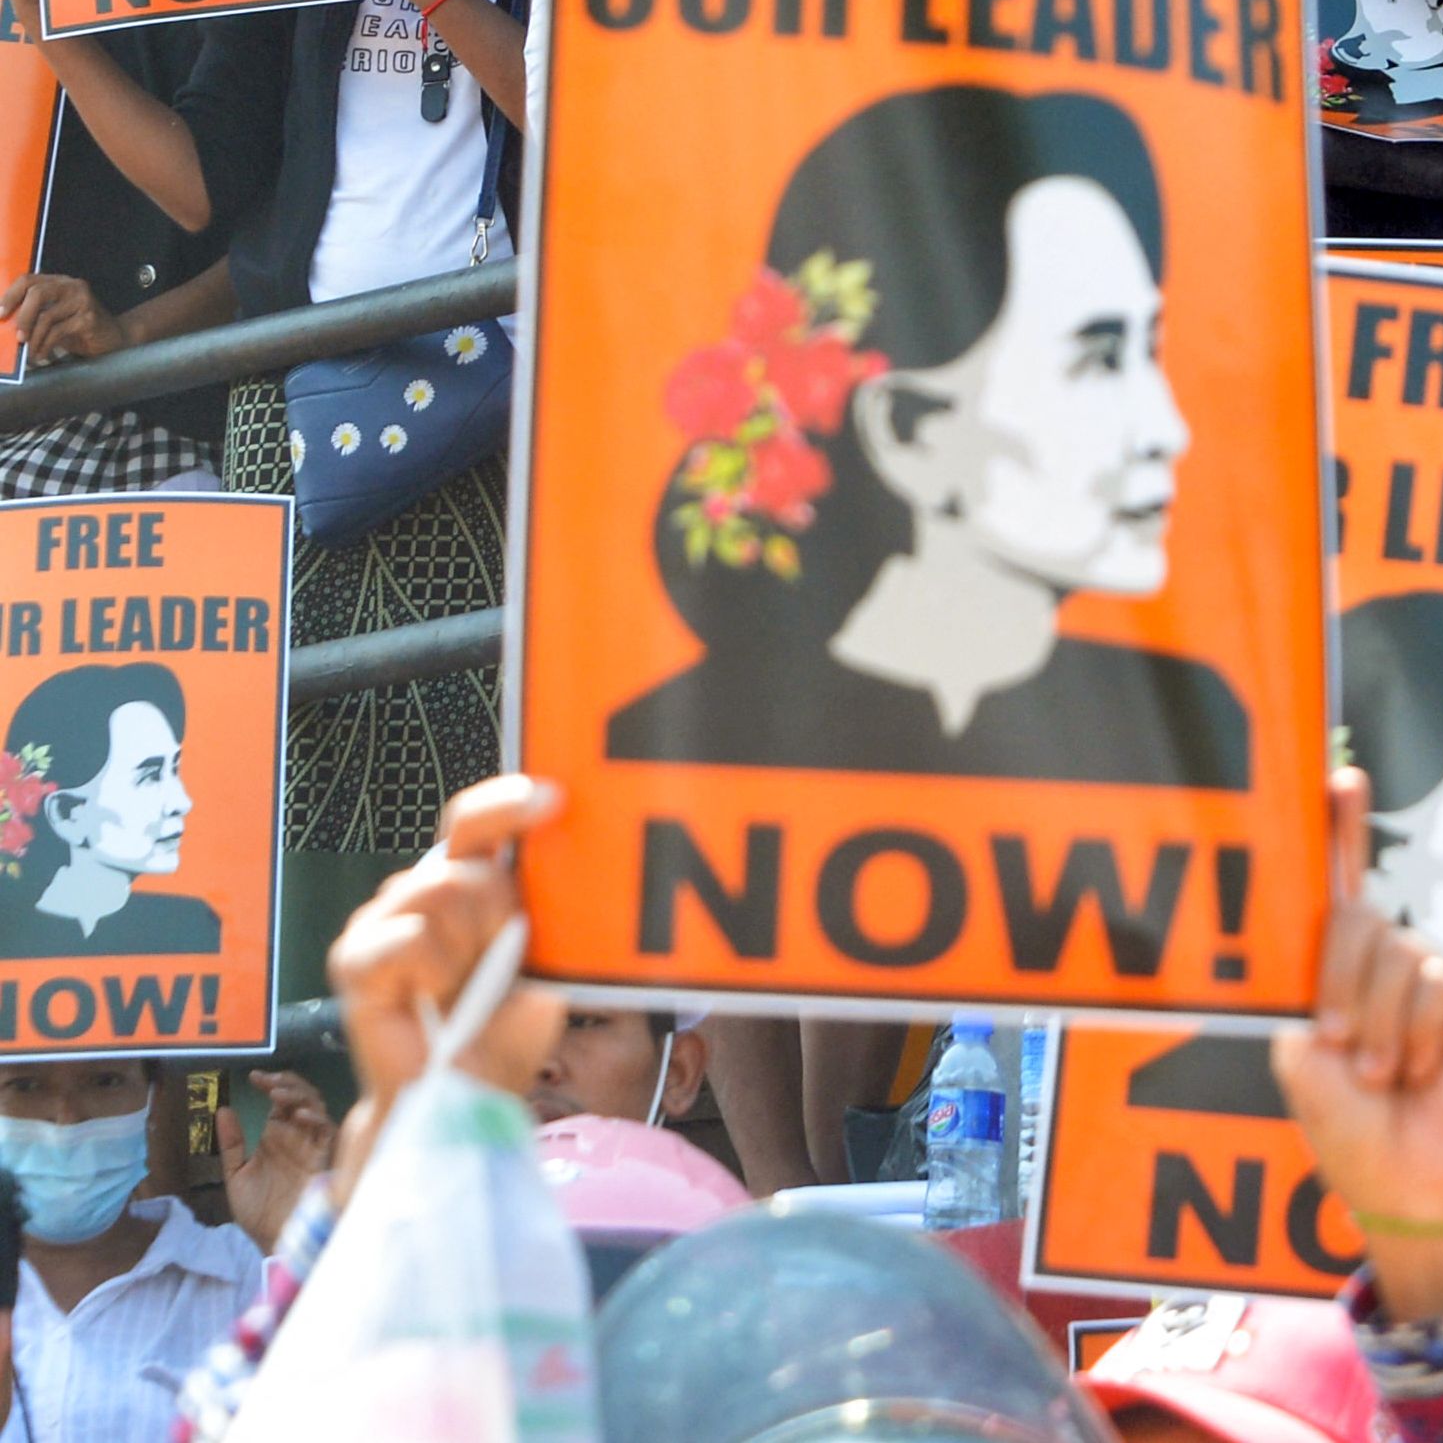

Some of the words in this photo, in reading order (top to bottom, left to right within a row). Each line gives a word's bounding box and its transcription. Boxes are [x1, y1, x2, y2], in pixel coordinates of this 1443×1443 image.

[37, 511, 165, 572] FREE
[59, 595, 271, 655] LEADER
[636, 816, 1252, 983] NOW!
